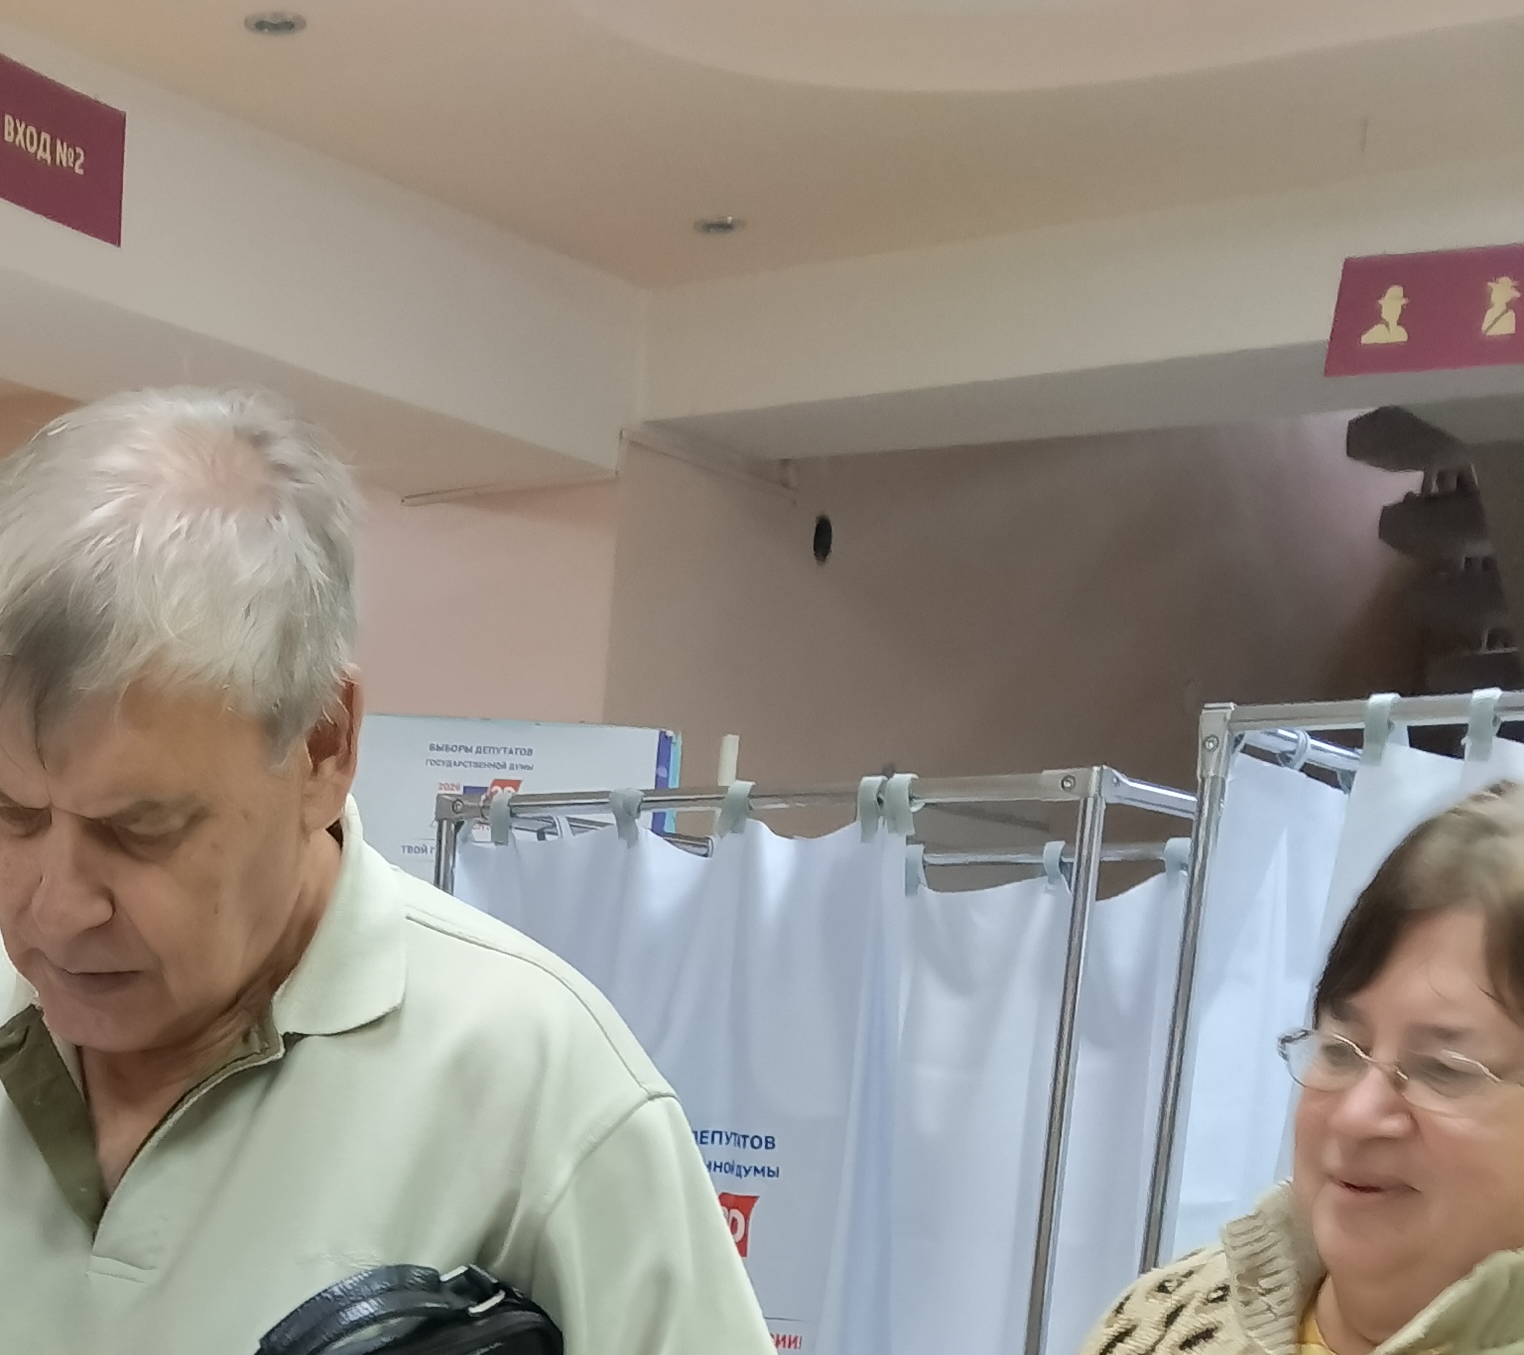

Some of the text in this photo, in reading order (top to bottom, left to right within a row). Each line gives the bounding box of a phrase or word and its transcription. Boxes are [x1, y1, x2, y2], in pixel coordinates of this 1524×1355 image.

[3, 114, 85, 175] ВХОД №2
[475, 745, 534, 757] ДЕПУТАТОВ
